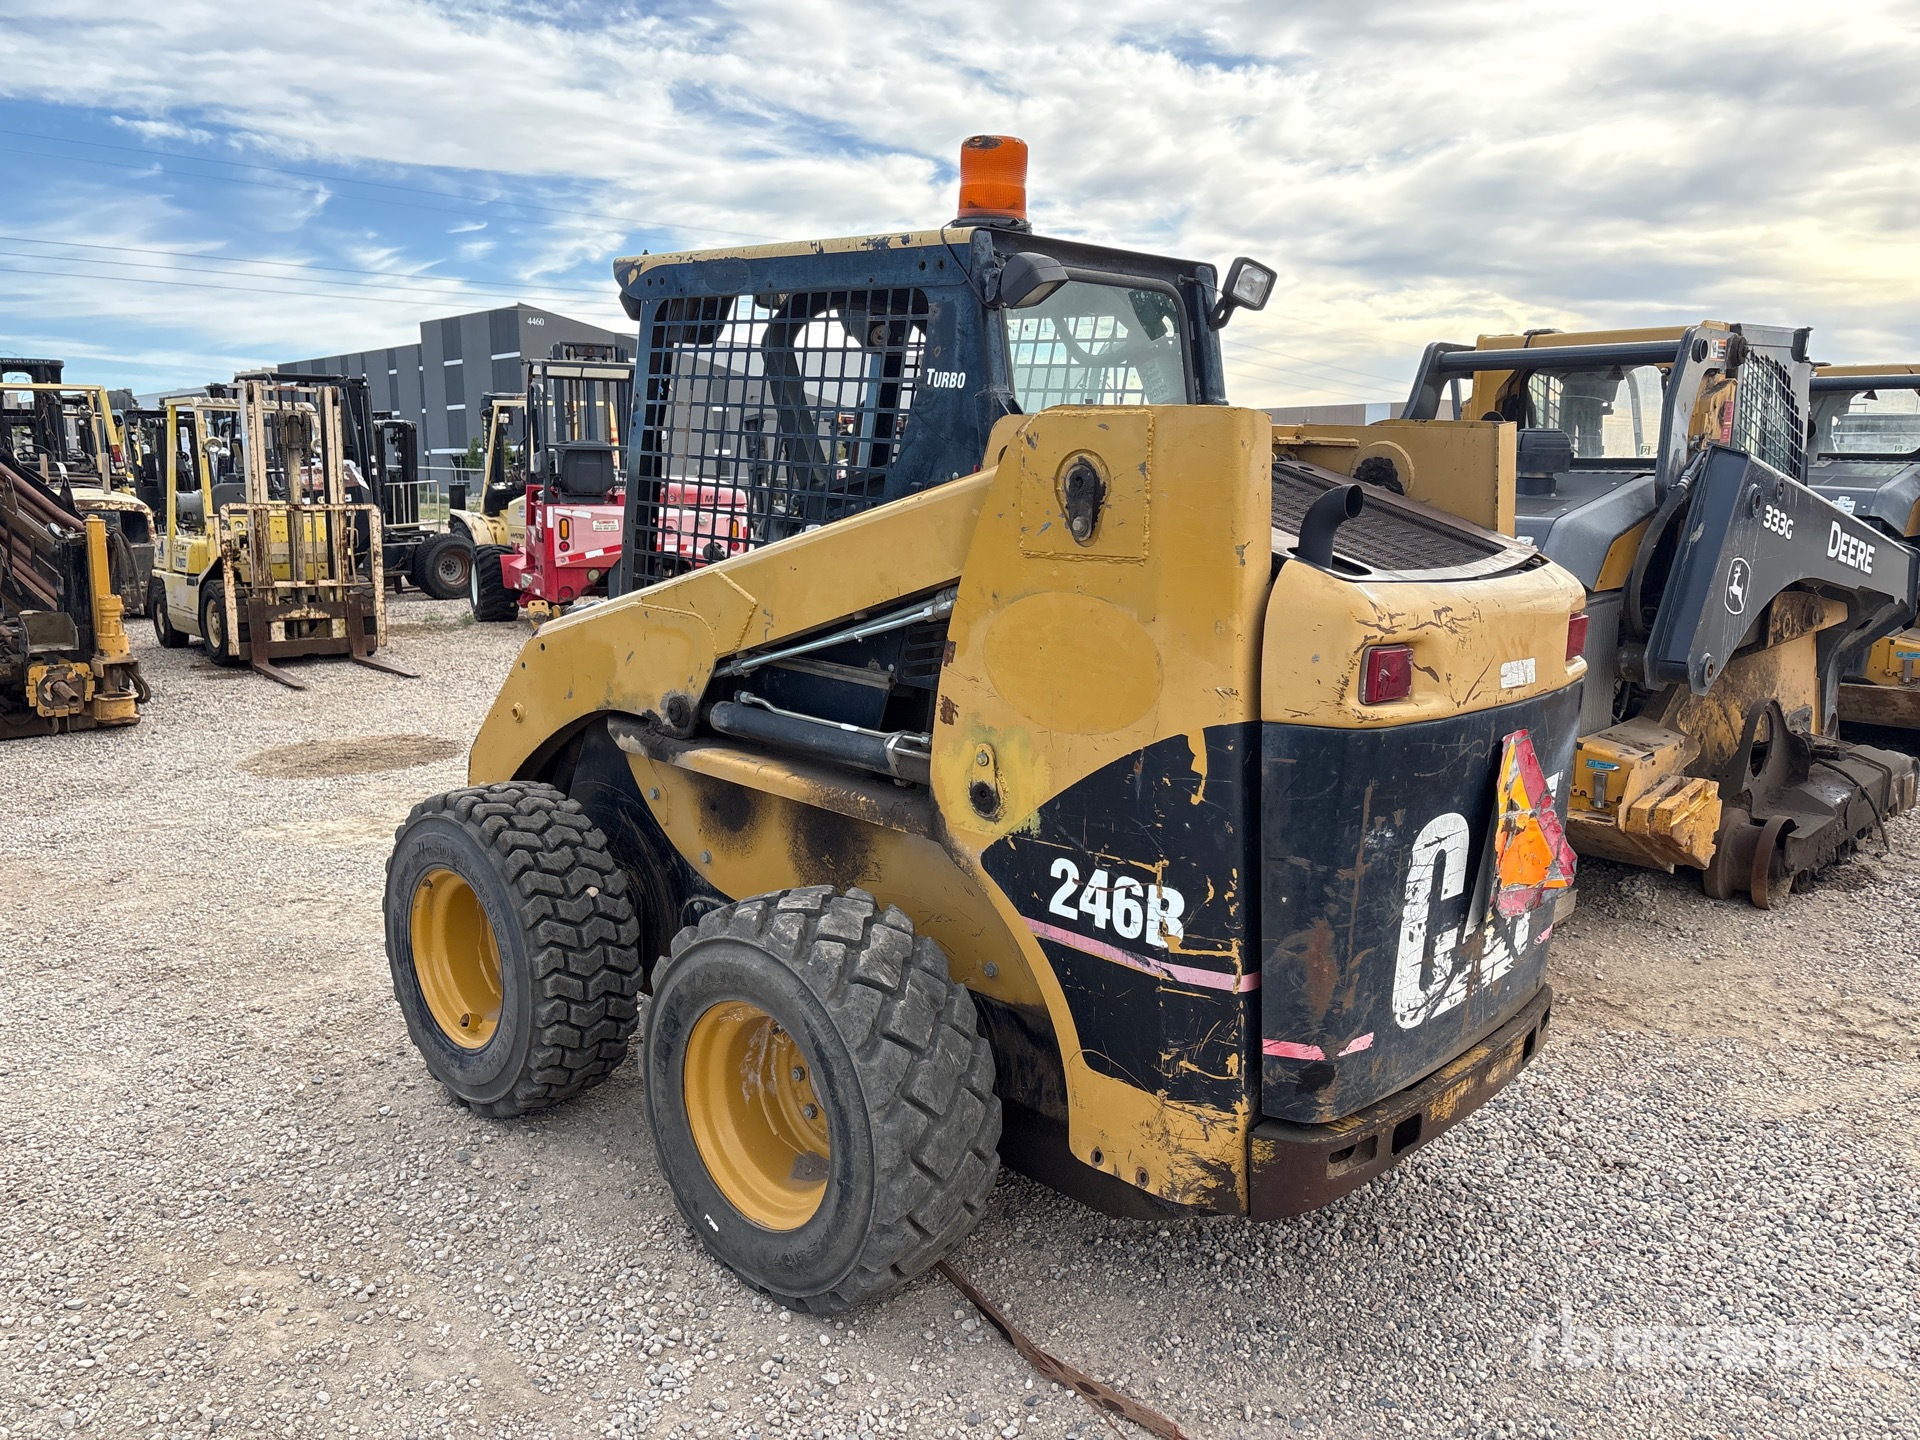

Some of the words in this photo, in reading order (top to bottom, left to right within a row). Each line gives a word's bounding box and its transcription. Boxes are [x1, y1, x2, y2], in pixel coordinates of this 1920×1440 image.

[527, 316, 545, 326] 4460
[927, 368, 966, 389] TURBO
[1763, 504, 1794, 540] 333G
[1827, 520, 1876, 574] DEERE
[1049, 857, 1185, 948] 246B
[1392, 770, 1560, 1029] CA
